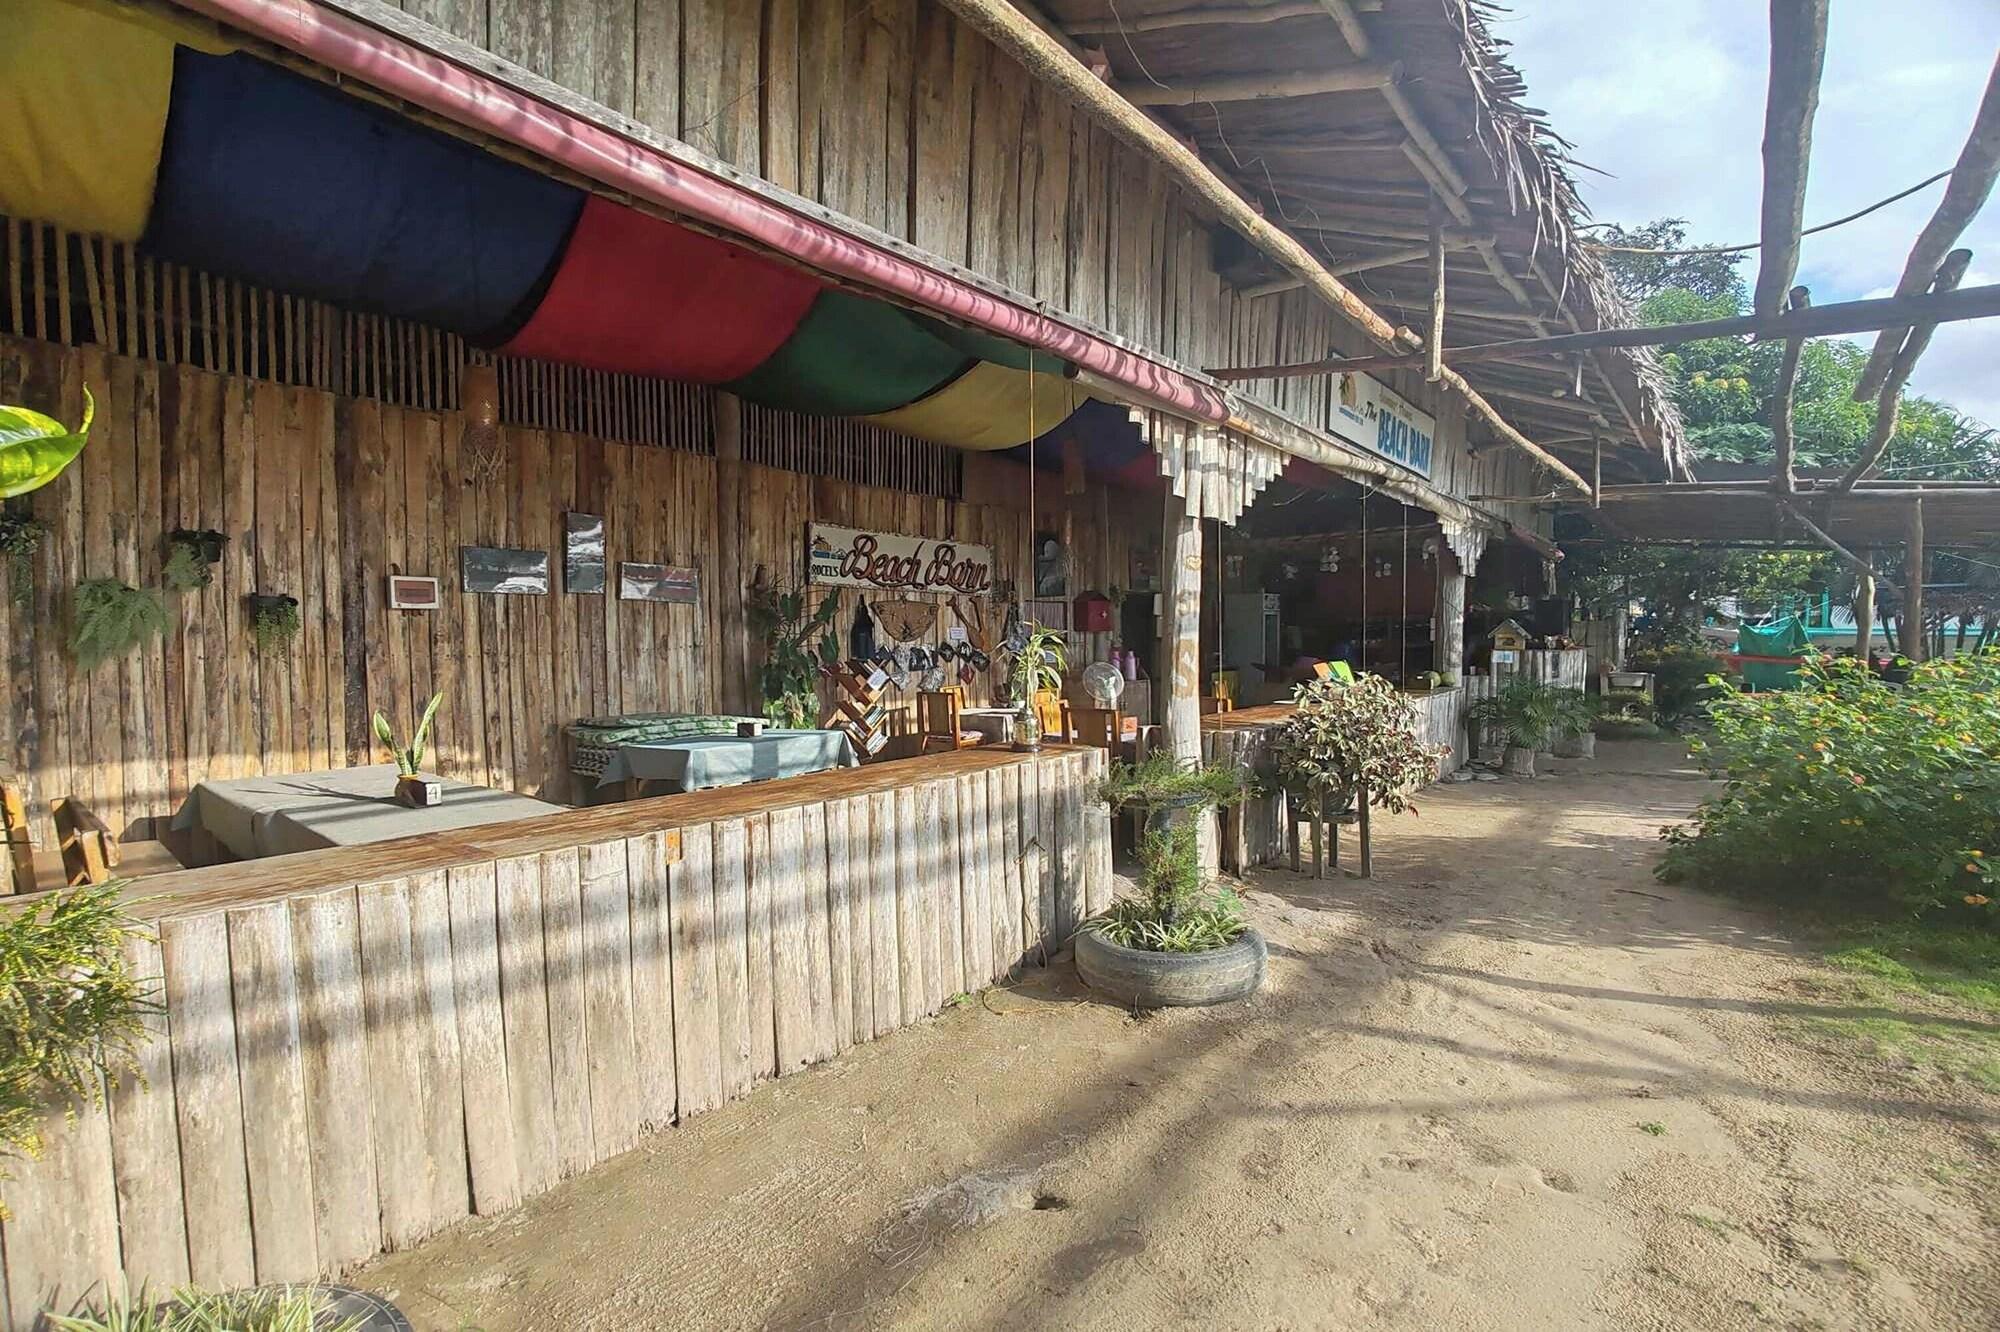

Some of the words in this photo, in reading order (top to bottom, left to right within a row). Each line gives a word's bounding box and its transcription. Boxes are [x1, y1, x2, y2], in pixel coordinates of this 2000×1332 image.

[1364, 401, 1378, 421] The
[1377, 408, 1408, 461] BEACH
[1409, 428, 1430, 472] BARN
[839, 534, 928, 590] Beach
[924, 543, 991, 594] Barn
[428, 786, 438, 800] 4
